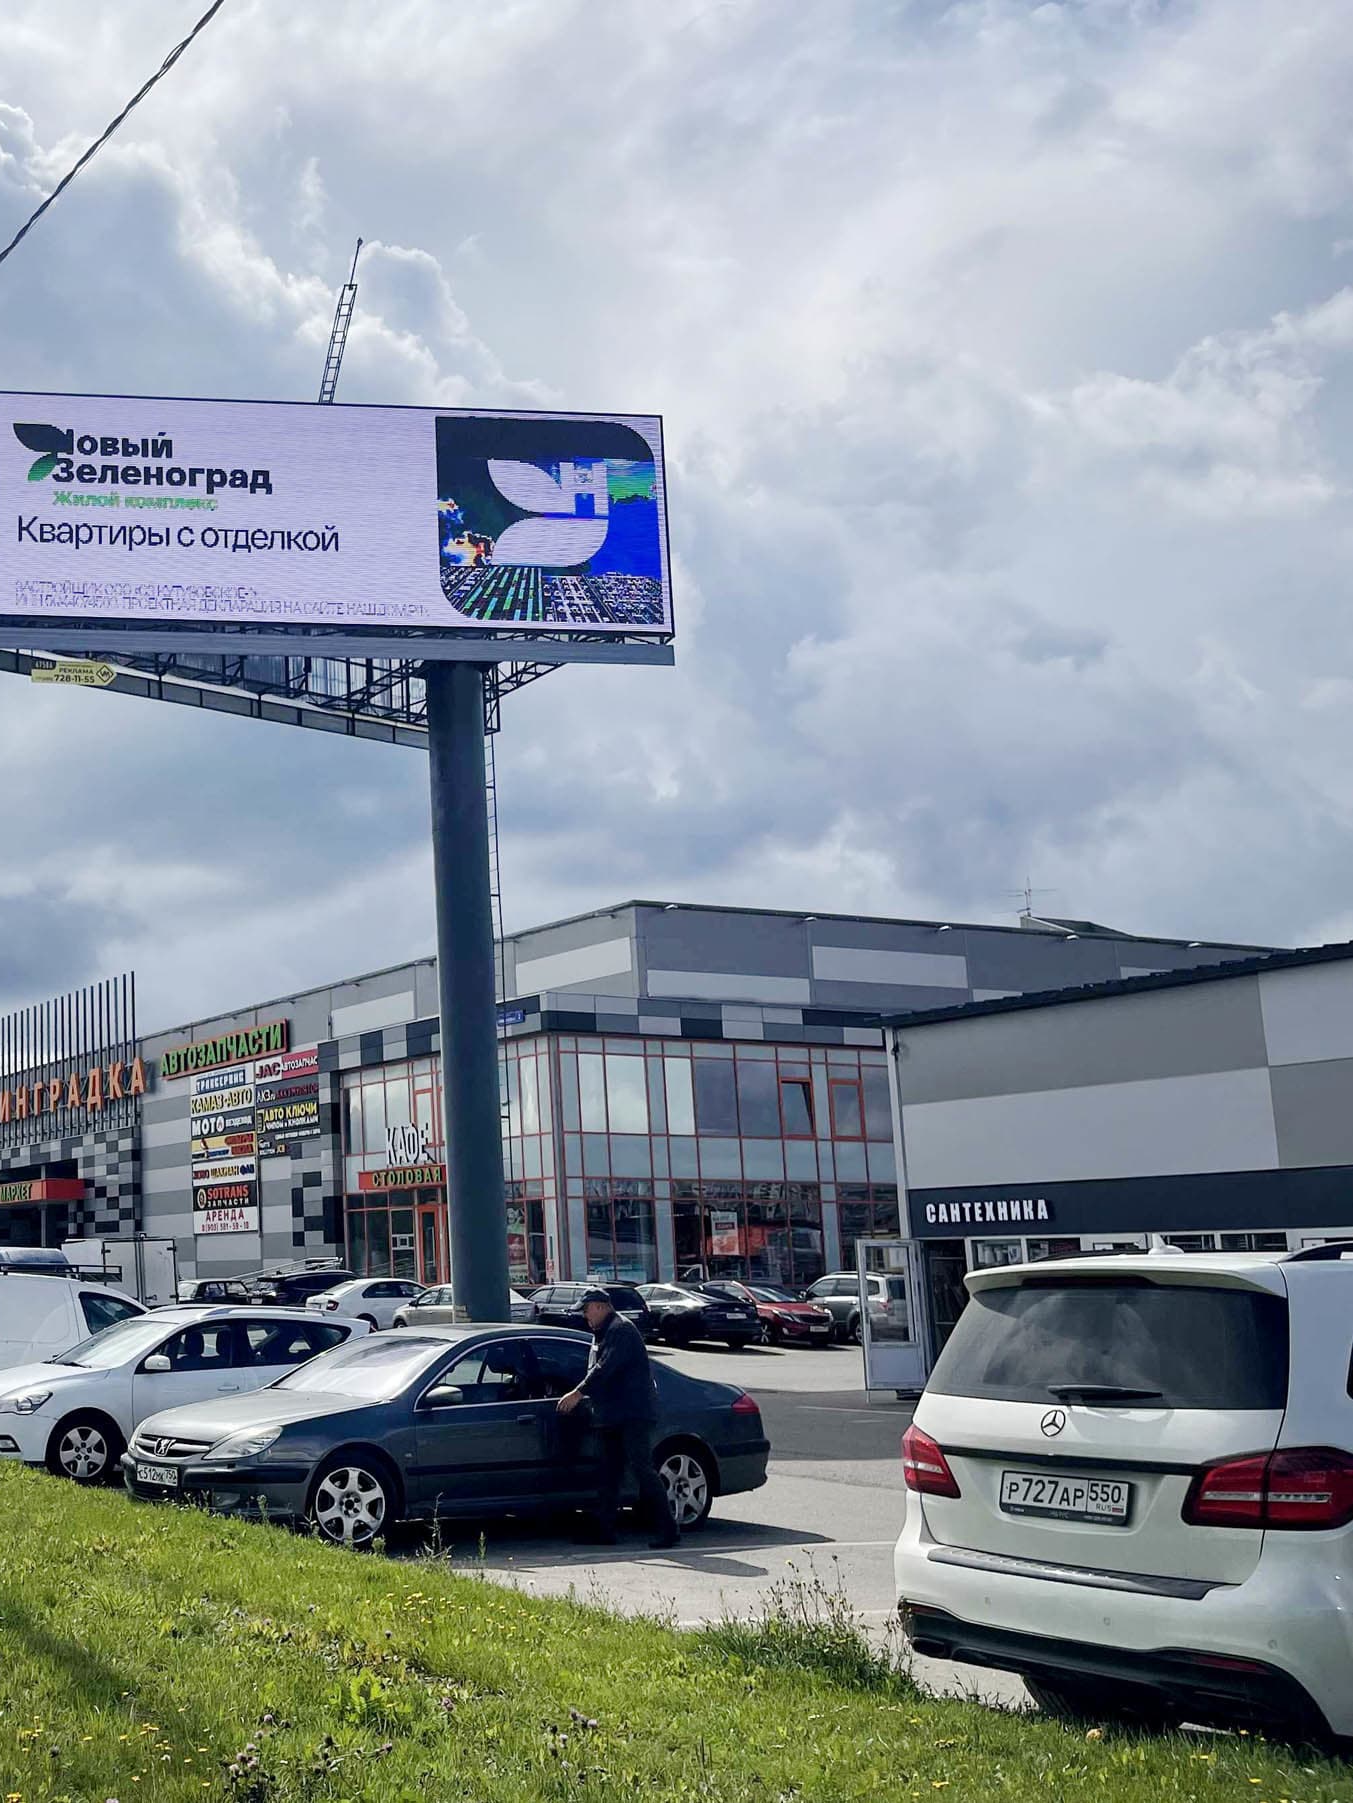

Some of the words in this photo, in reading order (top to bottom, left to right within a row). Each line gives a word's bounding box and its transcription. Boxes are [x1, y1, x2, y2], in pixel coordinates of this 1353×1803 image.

[52, 457, 272, 495] Зеленоград
[53, 491, 120, 508] Жилой
[124, 495, 218, 511] комплекс
[17, 515, 170, 550] Квартиры
[177, 526, 194, 547] с
[201, 525, 340, 553] отделкой
[160, 1023, 284, 1076] АВТОЗАПЧАСТИ
[256, 1062, 281, 1078] JAC
[264, 1107, 284, 1122] АВТО
[286, 1102, 317, 1118] КЛЮЧИ
[192, 1116, 225, 1136] МОТО
[386, 1123, 429, 1165] КАФЕ
[372, 1167, 442, 1187] СТОЛОВАЯ
[207, 1185, 249, 1200] SOTRANS
[207, 1198, 249, 1208] ЗАПЧАСТИ
[926, 1199, 1049, 1223] САНТЕХНИКА
[206, 1209, 244, 1222] АРЕНДА
[1008, 1478, 1085, 1507] Р727АР
[1089, 1483, 1122, 1503] 550
